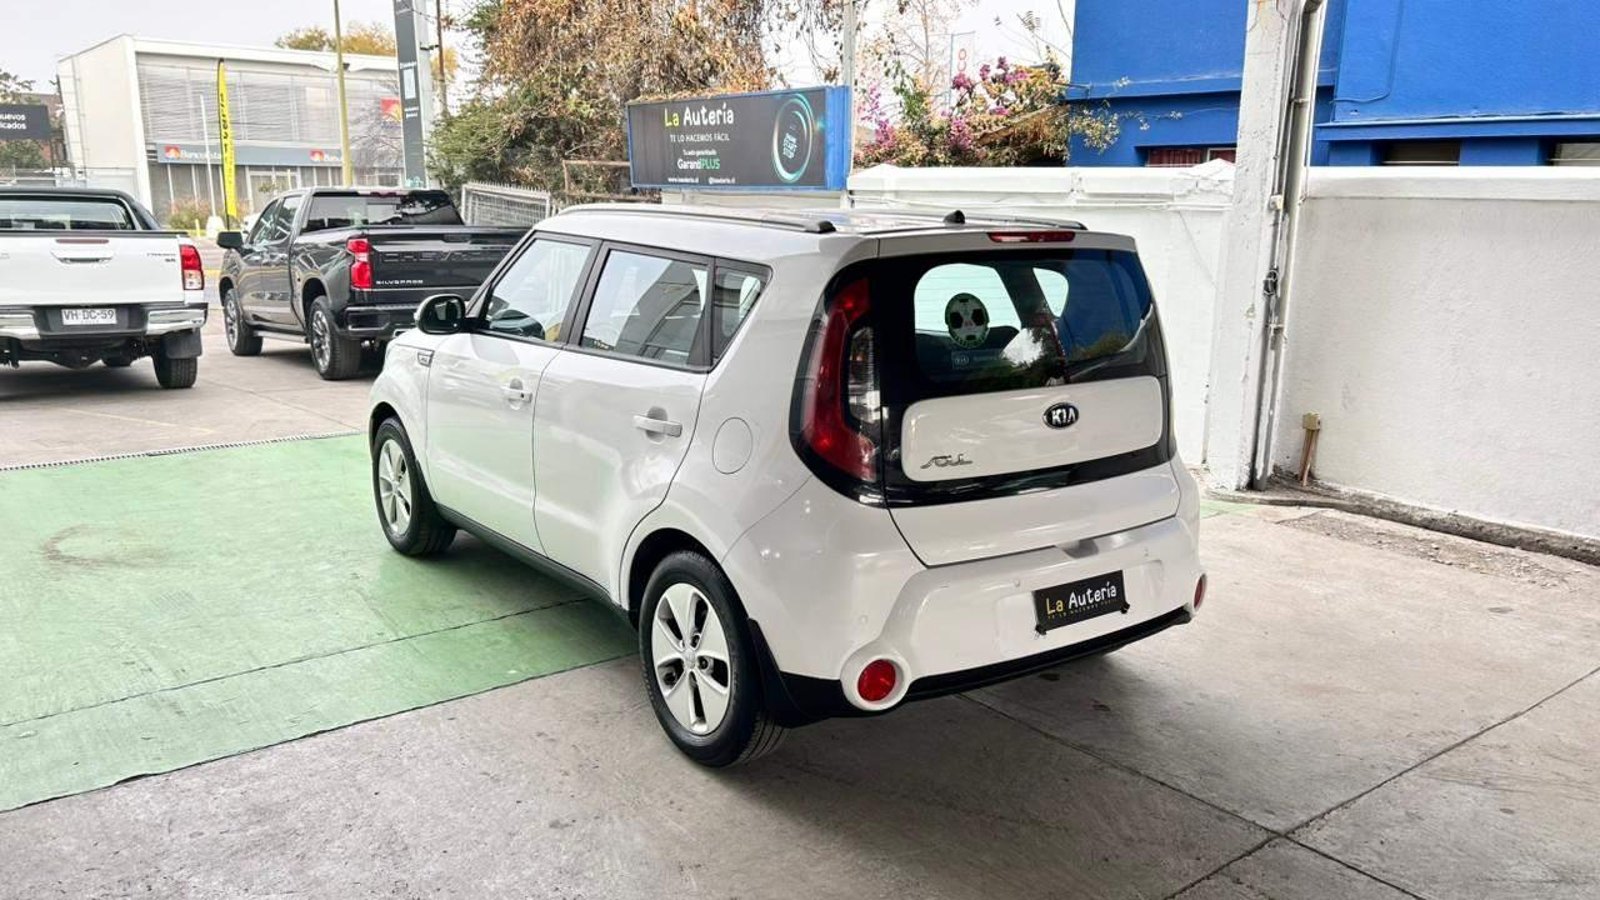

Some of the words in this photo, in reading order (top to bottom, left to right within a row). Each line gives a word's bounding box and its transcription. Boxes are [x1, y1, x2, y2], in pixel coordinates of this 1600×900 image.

[664, 107, 680, 127] La
[683, 102, 734, 126] Autería
[1051, 406, 1077, 425] KIA
[1046, 597, 1065, 616] La
[1068, 581, 1117, 610] Autería
